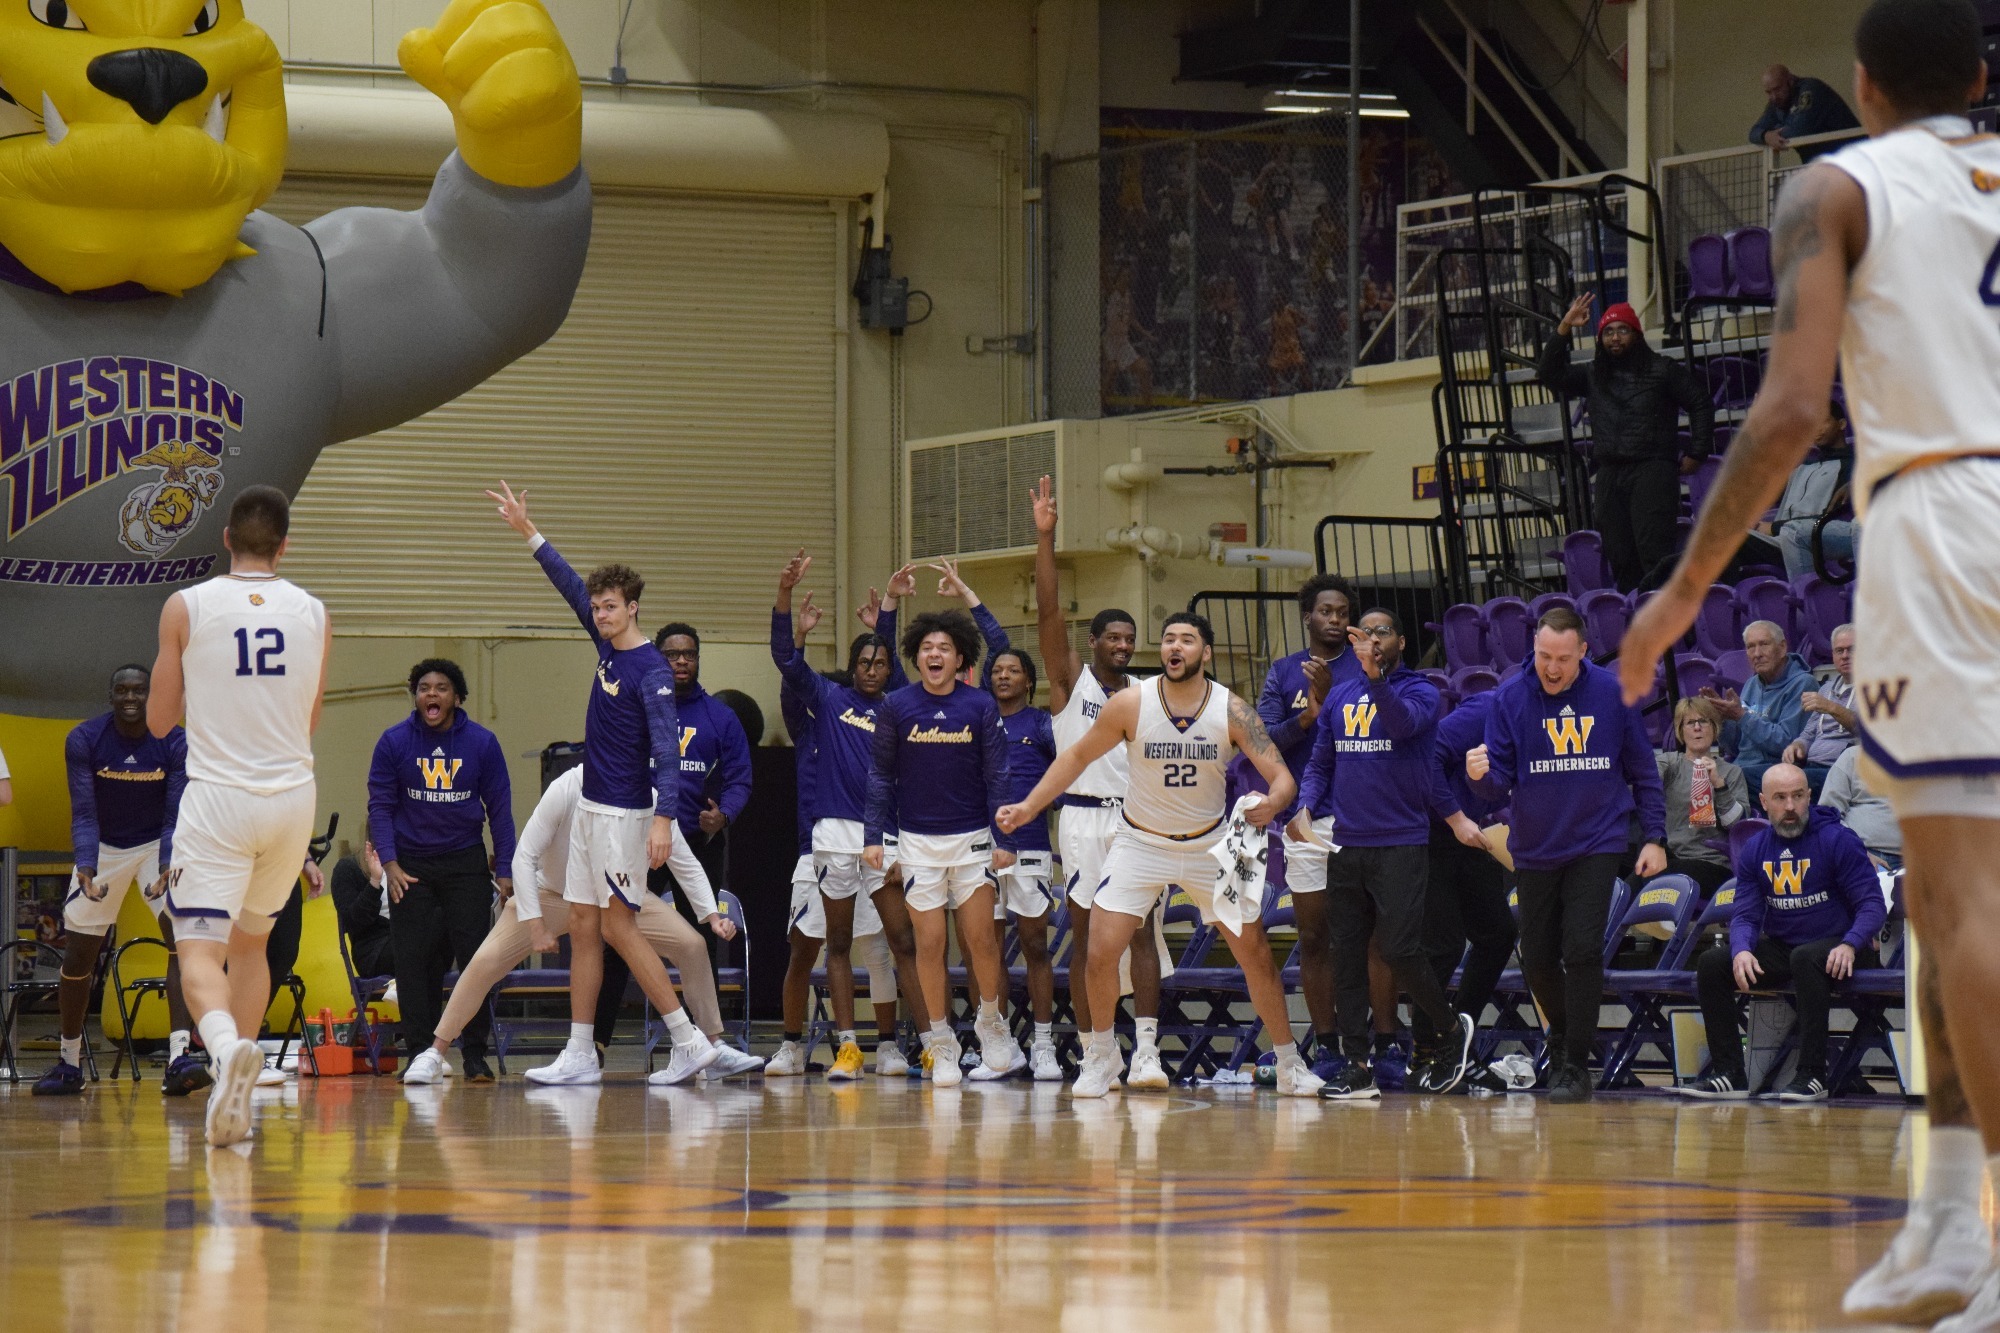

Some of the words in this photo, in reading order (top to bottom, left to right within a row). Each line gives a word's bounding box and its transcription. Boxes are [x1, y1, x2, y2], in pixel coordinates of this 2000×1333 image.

[0, 355, 244, 468] WESTERN
[0, 413, 225, 543] ILLINOIS
[0, 553, 218, 587] LEATHERNECKS
[234, 627, 286, 676] 12
[1863, 677, 1910, 720] W
[907, 723, 973, 743] Leathernecks
[1342, 703, 1377, 738] W
[1542, 715, 1595, 756] W
[1144, 742, 1183, 759] WESTERN
[1184, 743, 1218, 761] ILLINOIS
[1529, 756, 1611, 774] LEATHERNECKS
[416, 757, 463, 790] W
[1163, 763, 1198, 788] 22
[1762, 858, 1811, 895] W
